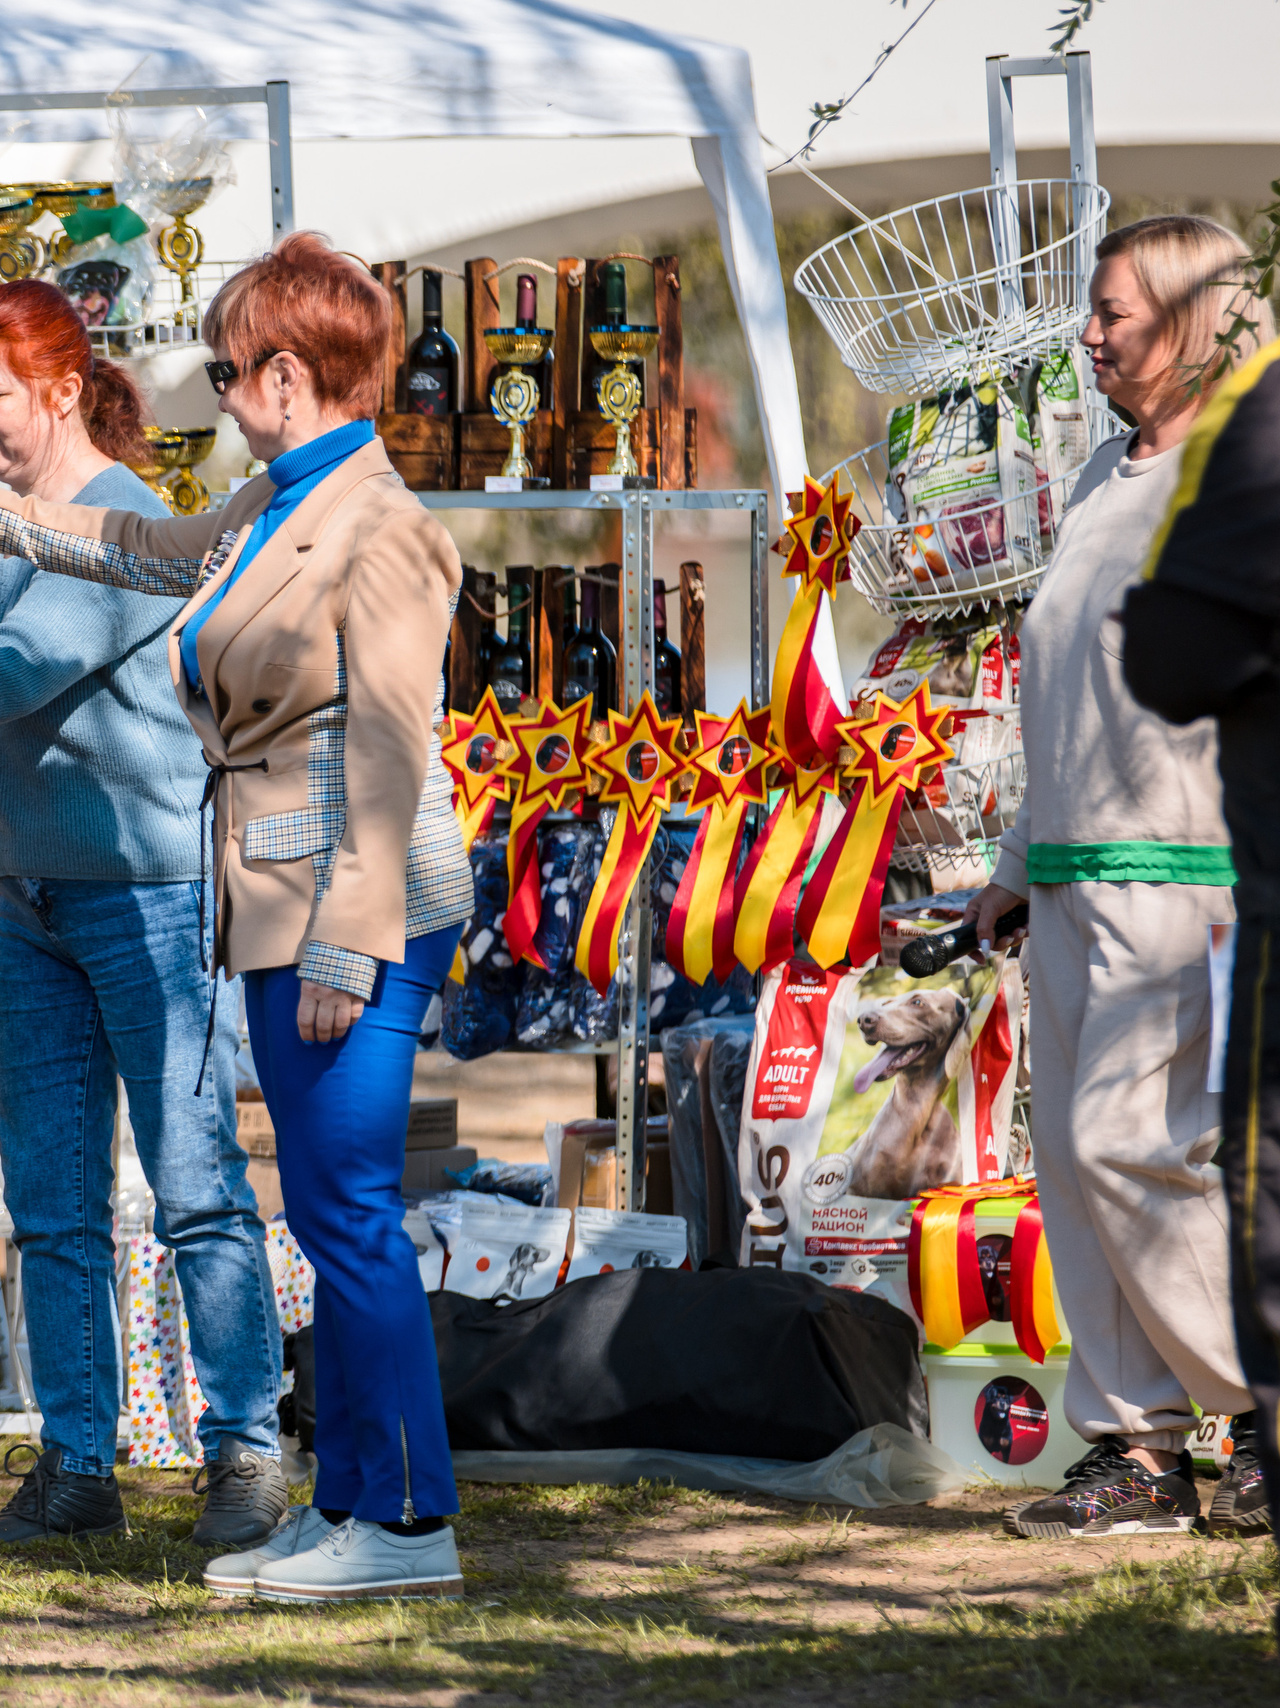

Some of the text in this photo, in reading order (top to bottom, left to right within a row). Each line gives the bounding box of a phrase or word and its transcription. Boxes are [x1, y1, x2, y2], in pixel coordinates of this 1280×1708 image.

[763, 1064, 810, 1085] ADULT
[813, 1172, 845, 1187] 40%
[812, 1207, 869, 1221] МЯСНОЙ
[811, 1220, 865, 1233] РАЦИОН
[823, 1240, 858, 1251] Комплекс
